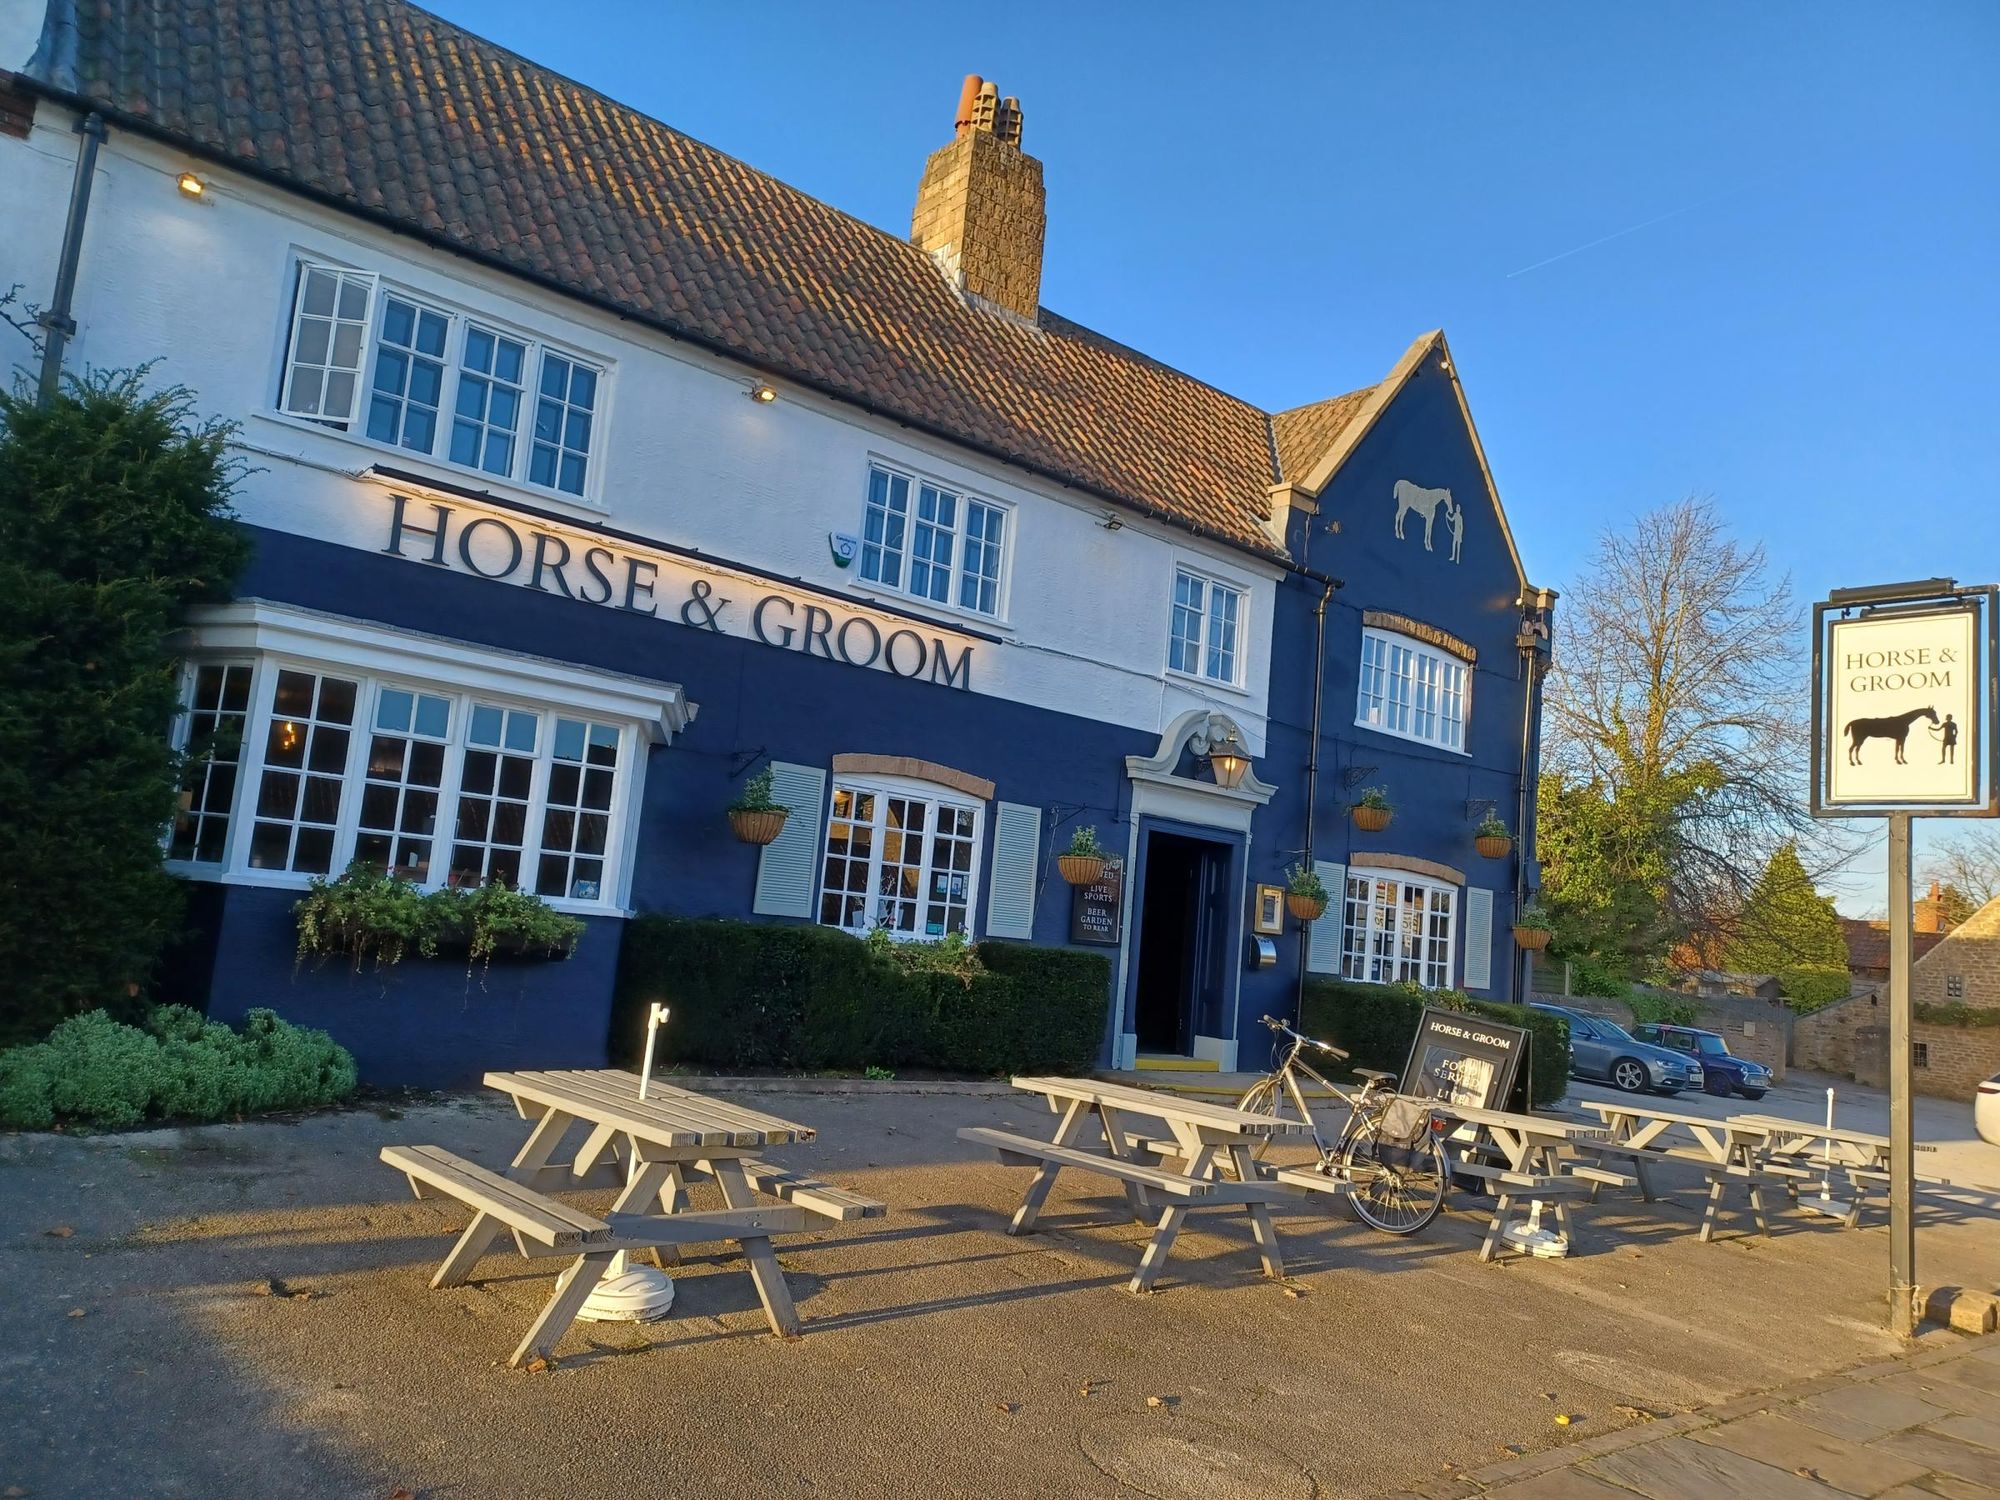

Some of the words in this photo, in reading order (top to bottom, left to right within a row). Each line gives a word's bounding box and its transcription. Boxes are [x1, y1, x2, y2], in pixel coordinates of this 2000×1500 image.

[381, 494, 659, 618] HORSE
[680, 579, 732, 635] &
[753, 594, 975, 693] GROOM
[1846, 648, 1931, 670] HORSE
[1938, 647, 1958, 663] &
[1850, 671, 1952, 693] GROOM
[1090, 885, 1107, 893] LIVE
[1084, 892, 1113, 902] SPORTS
[1087, 907, 1107, 916] BEER
[1080, 915, 1113, 926] GARDEN
[1093, 924, 1109, 932] REAR
[1430, 1021, 1462, 1037] HORSE
[1462, 1031, 1471, 1040] &
[1472, 1032, 1511, 1050] GROOM
